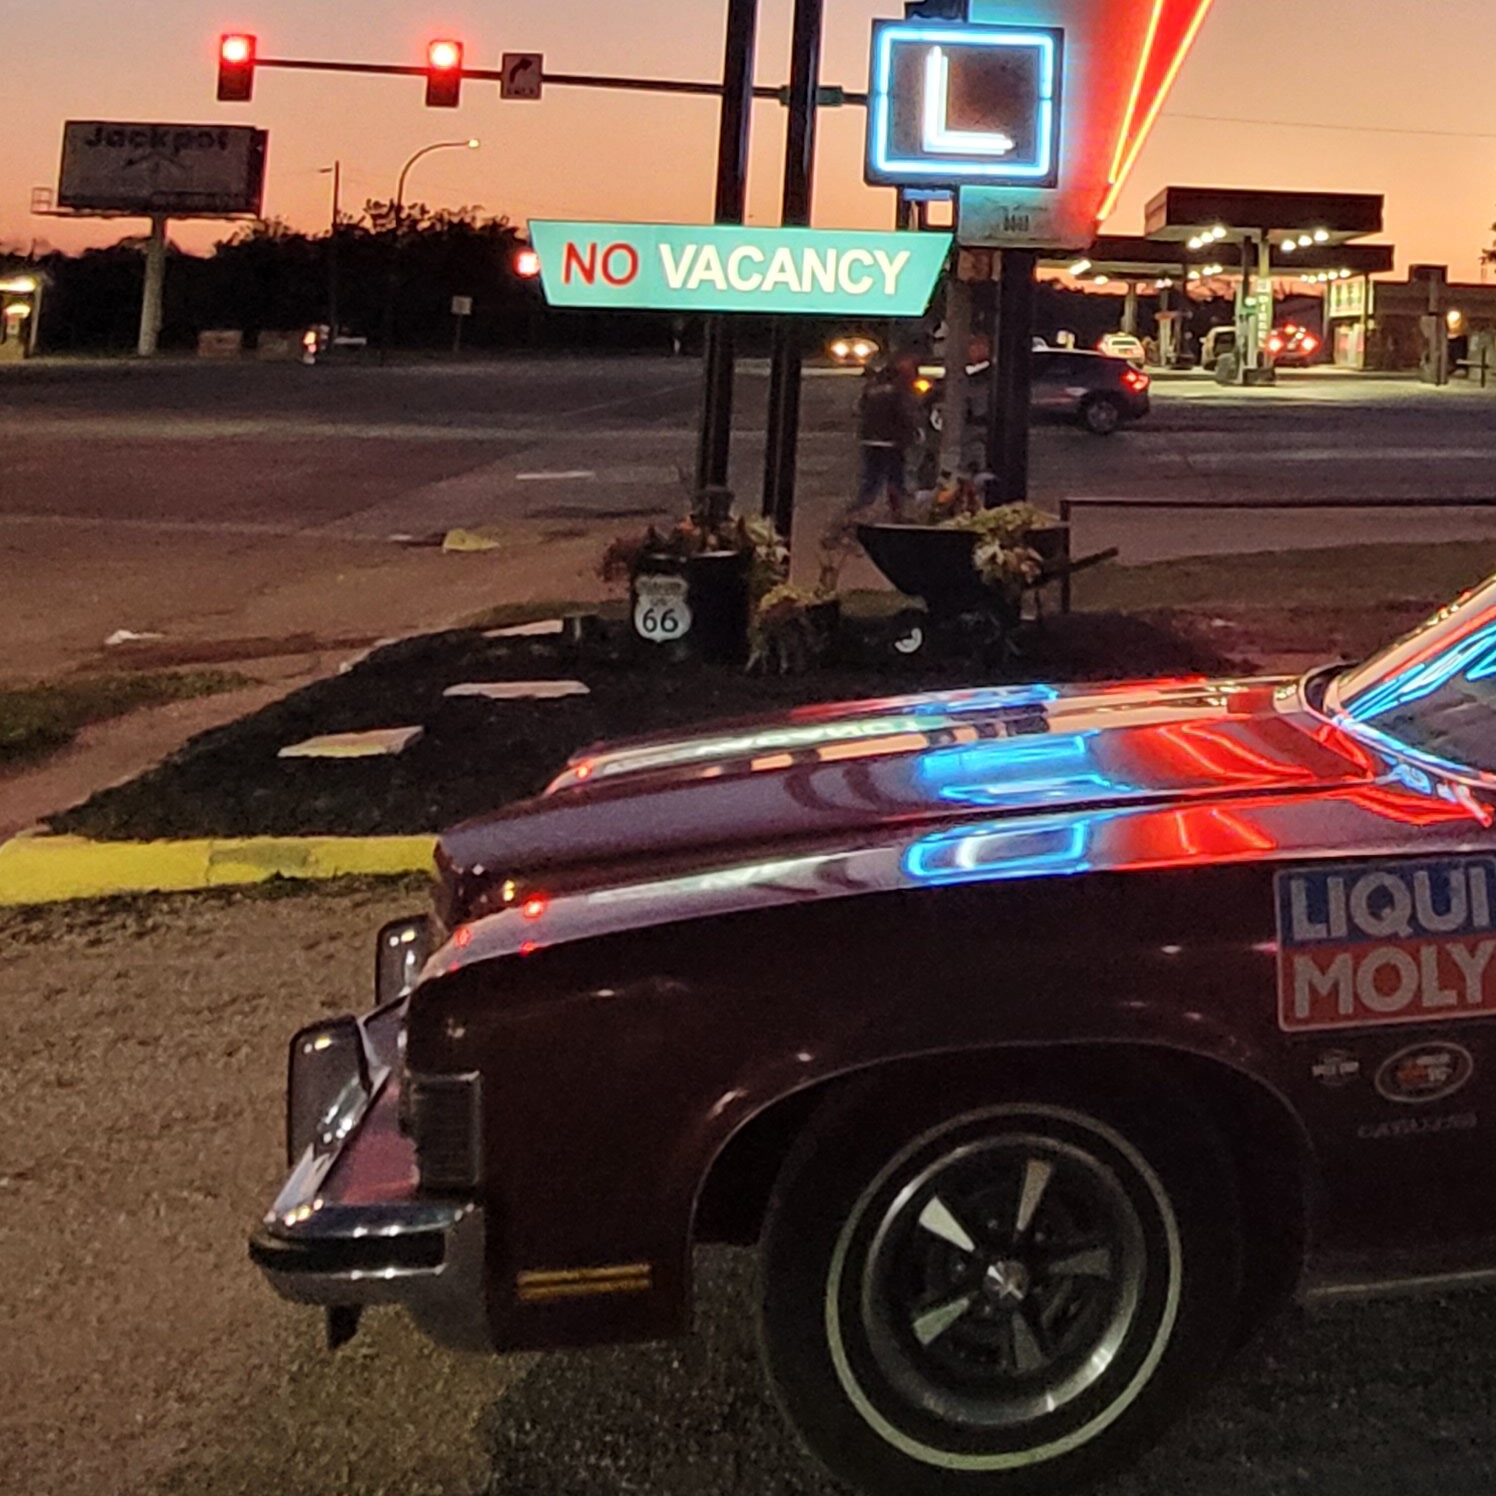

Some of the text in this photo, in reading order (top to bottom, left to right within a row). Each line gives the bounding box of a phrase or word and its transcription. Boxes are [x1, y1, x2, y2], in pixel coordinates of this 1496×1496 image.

[84, 126, 230, 156] Jackpot
[563, 242, 910, 295] NO VACANCY
[643, 608, 679, 633] 66
[1290, 866, 1491, 940] LIQUI
